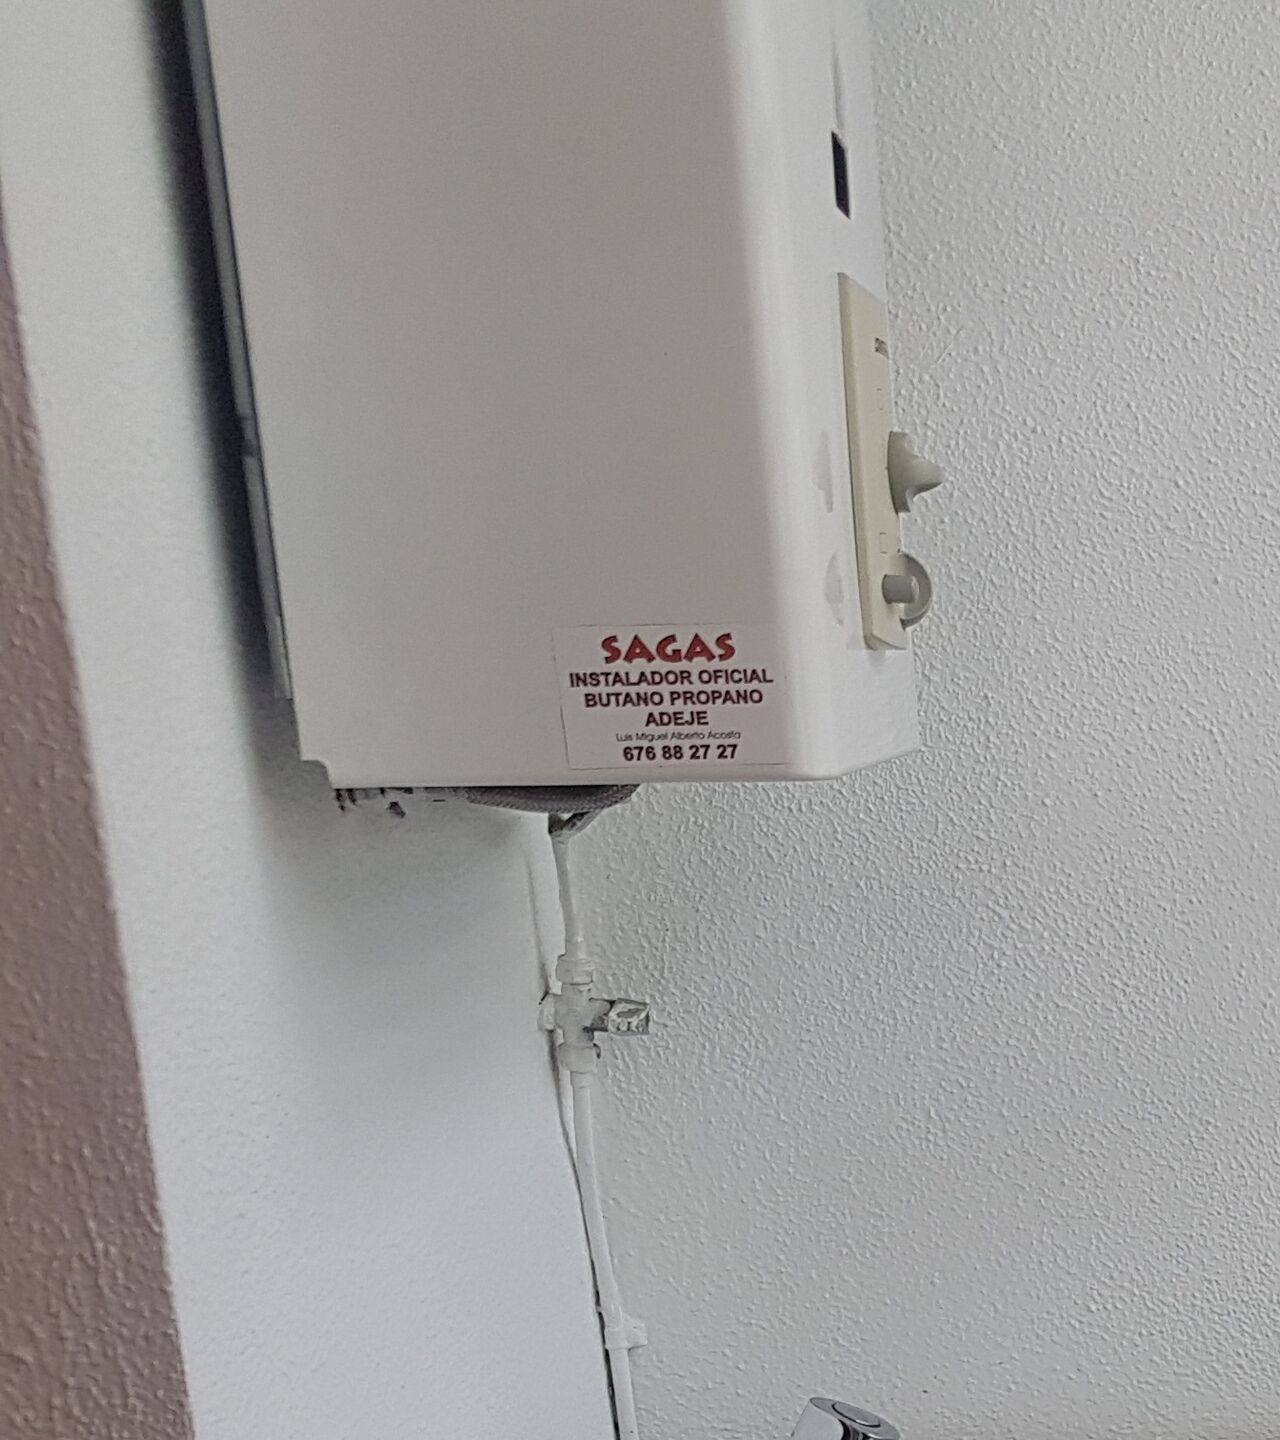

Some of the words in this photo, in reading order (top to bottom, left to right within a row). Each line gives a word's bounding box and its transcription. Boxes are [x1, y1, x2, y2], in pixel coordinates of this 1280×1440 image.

[601, 632, 736, 664] SAGAS
[569, 670, 693, 687] INSTALADOR
[698, 668, 774, 685] OFICIAL
[584, 691, 664, 708] BUTANO
[669, 689, 763, 706] PROPANO
[645, 711, 709, 727] ADEJE
[615, 732, 633, 742] Luis
[635, 732, 668, 743] Miguel
[707, 730, 741, 740] Acosta
[623, 746, 656, 761] 676
[662, 745, 684, 760] 88
[689, 744, 711, 760] 27
[716, 744, 738, 759] 27
